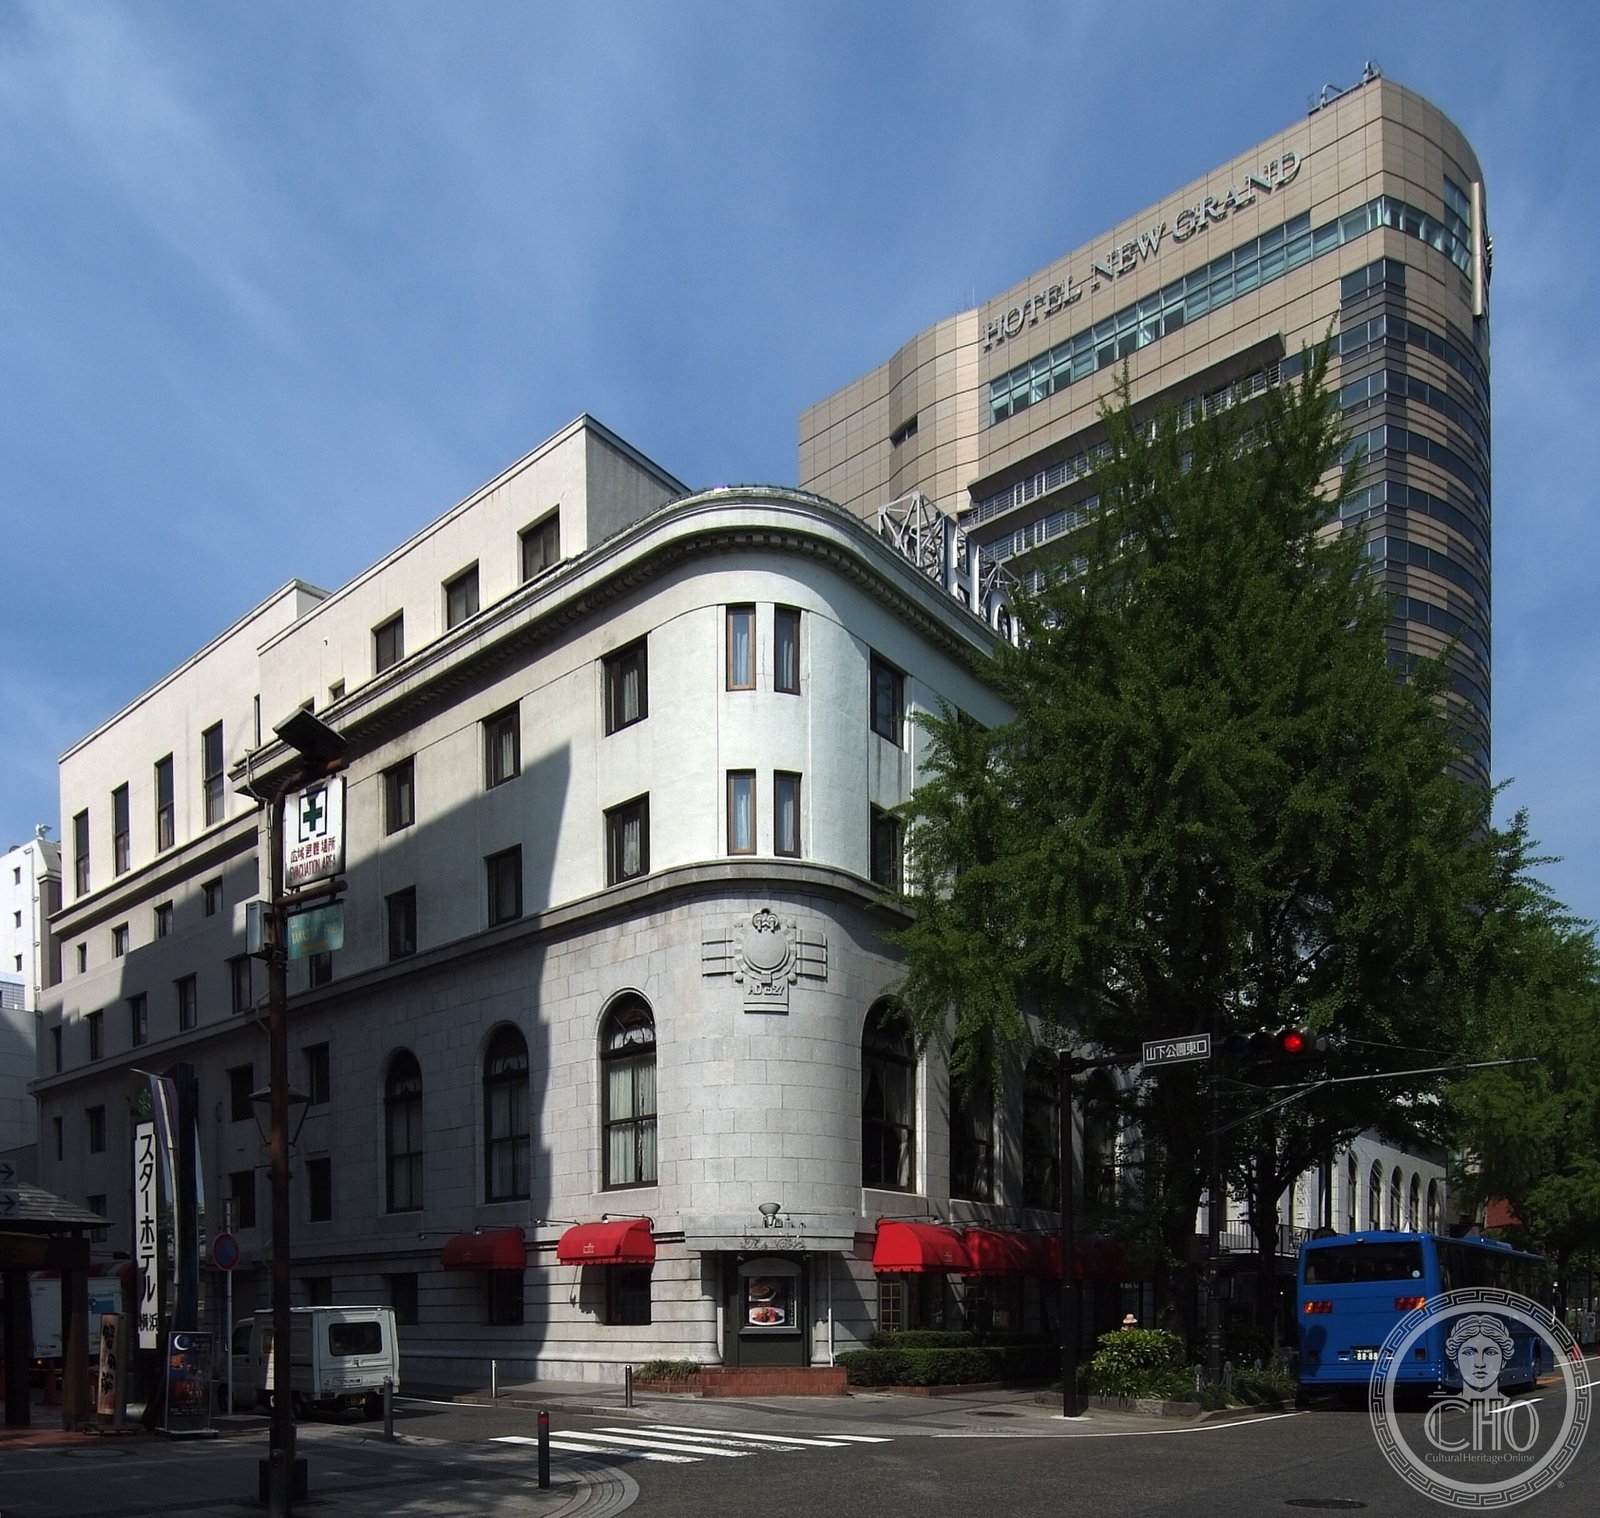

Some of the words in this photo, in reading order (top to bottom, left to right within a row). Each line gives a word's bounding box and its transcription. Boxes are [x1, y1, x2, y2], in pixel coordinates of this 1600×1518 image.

[983, 275, 1082, 352] HOTEL
[1091, 221, 1166, 290] NEW
[1172, 150, 1301, 241] GRAND
[1146, 1040, 1207, 1061] 山下公園東口
[139, 1134, 156, 1304] スターホテル
[138, 1313, 159, 1332] 横浜
